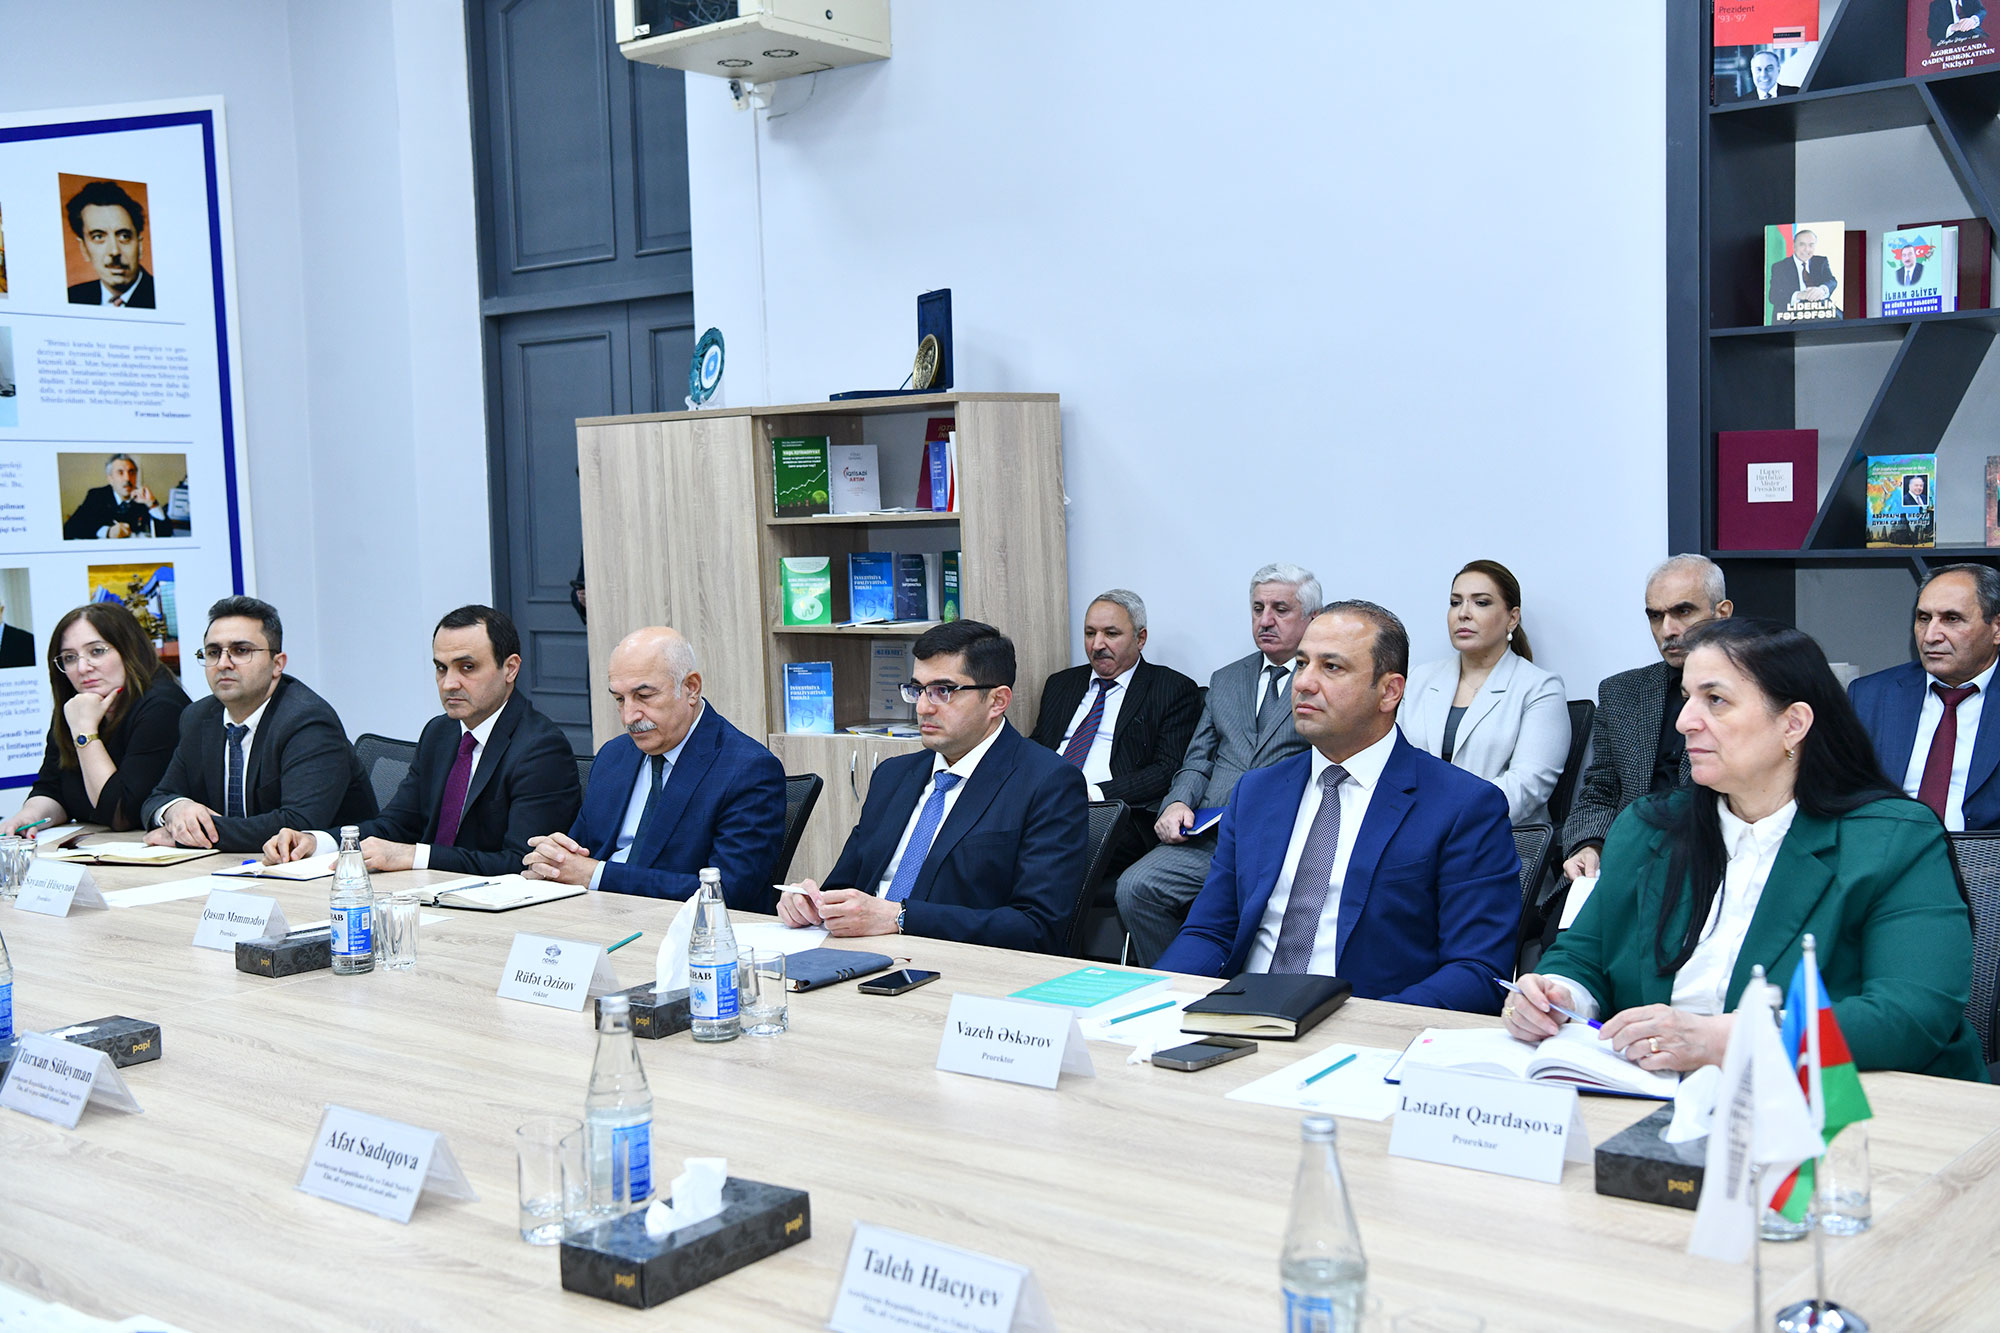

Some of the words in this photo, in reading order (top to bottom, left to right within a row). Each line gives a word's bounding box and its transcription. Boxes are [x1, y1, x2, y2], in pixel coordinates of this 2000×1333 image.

[1718, 6, 1754, 14] Prezident
[1922, 56, 1944, 66] QADIN
[1945, 48, 1996, 62] HƏRƏKATININ
[1930, 43, 1987, 58] AZƏRBAYCANDA
[1942, 58, 1974, 70] İNKİŞAFI
[1885, 290, 1907, 300] İLHAM
[1910, 288, 1938, 298] ƏLİYEV
[1776, 308, 1836, 320] FƏLSƏFƏSİ
[1786, 300, 1836, 312] LİDERLİK
[203, 908, 225, 921] Qasım
[226, 912, 265, 926] Məmmədov
[514, 969, 542, 986] Rüfət
[543, 975, 576, 991] Əzizov
[636, 1016, 650, 1027] papi
[957, 1021, 994, 1040] Vazeh
[998, 1027, 1054, 1048] Əskərov
[132, 1040, 150, 1054] papi
[18, 1048, 49, 1070] Turxan
[49, 1056, 93, 1084] Süleyman
[982, 1052, 1014, 1064] Prorektor
[1401, 1096, 1461, 1119] Lətafət
[1466, 1106, 1564, 1136] Qardaşova
[325, 1130, 356, 1153] Afət
[356, 1136, 419, 1170] Sadıqova
[1667, 1178, 1694, 1195] papi
[784, 1212, 804, 1236] papi
[614, 1272, 636, 1290] papi
[863, 1247, 914, 1284] Taleh
[920, 1264, 1004, 1308] Hacıyev
